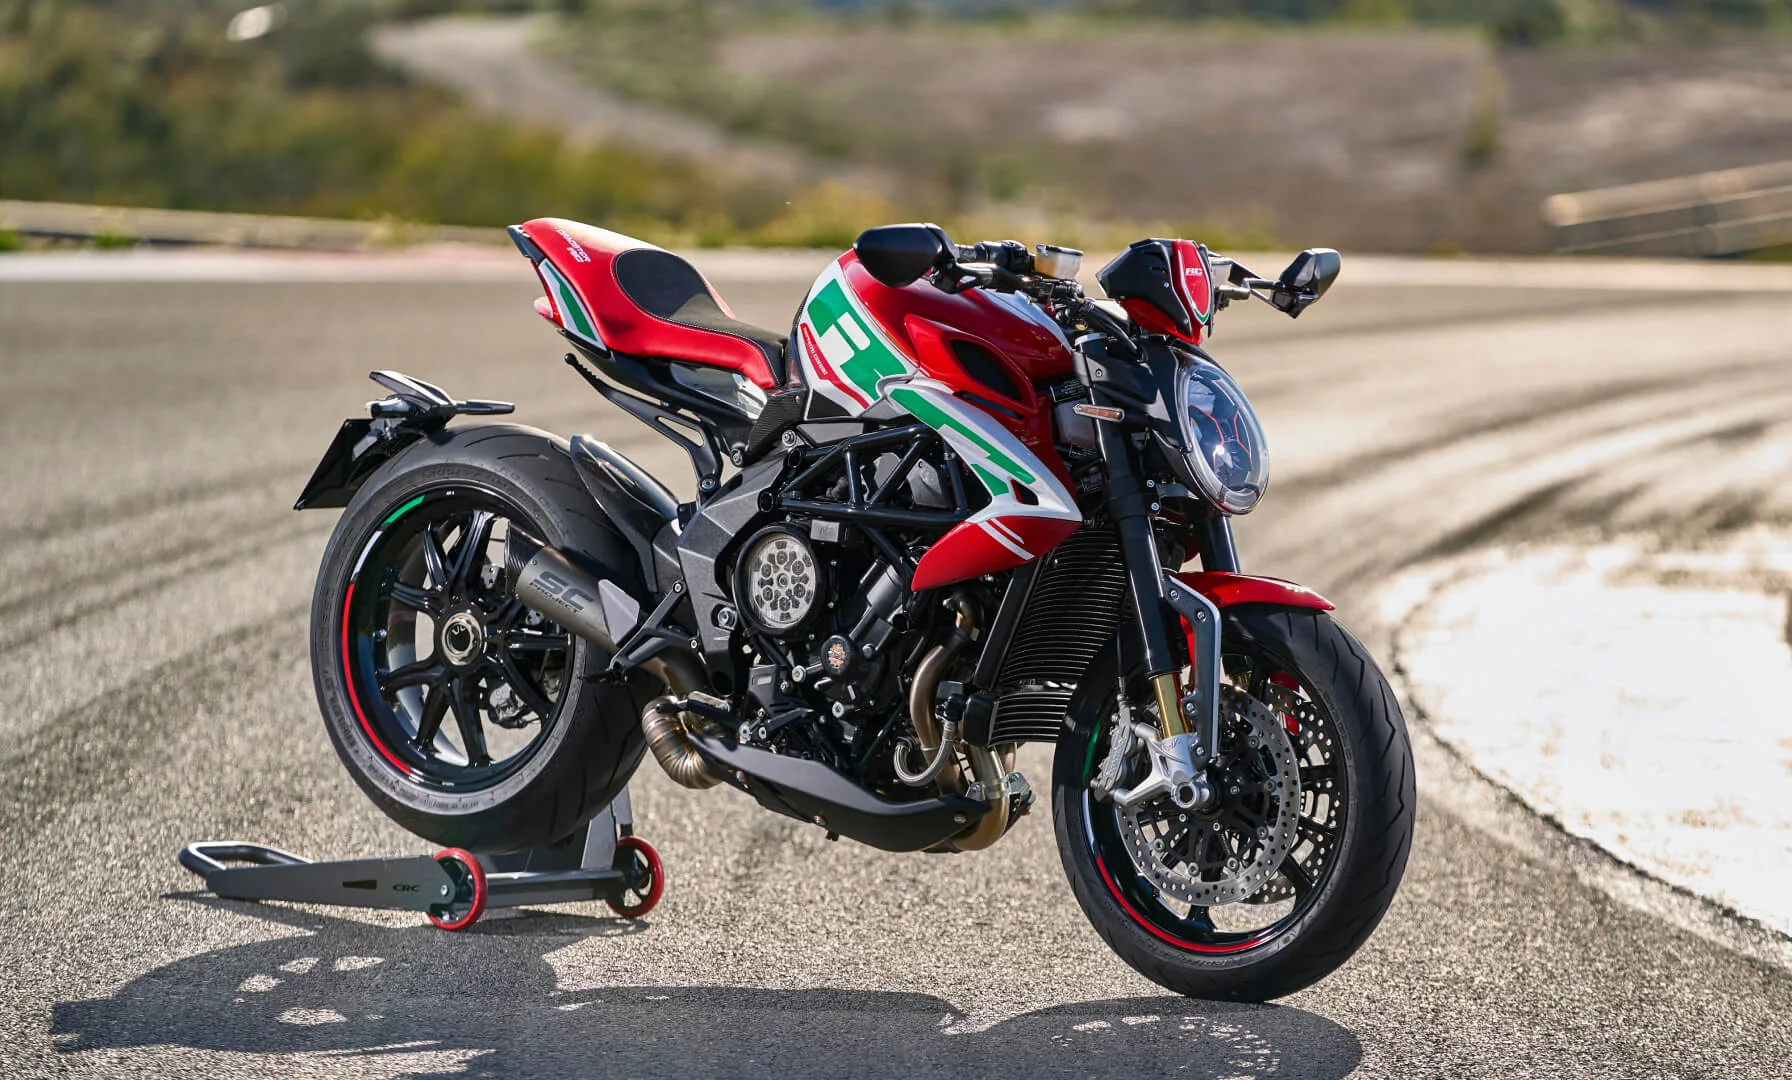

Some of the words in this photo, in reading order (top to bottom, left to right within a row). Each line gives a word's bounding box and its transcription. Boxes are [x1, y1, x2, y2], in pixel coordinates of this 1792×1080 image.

[1184, 267, 1203, 276] RC
[529, 582, 581, 614] PROJECT
[533, 571, 595, 611] SC
[392, 883, 421, 892] CRC
